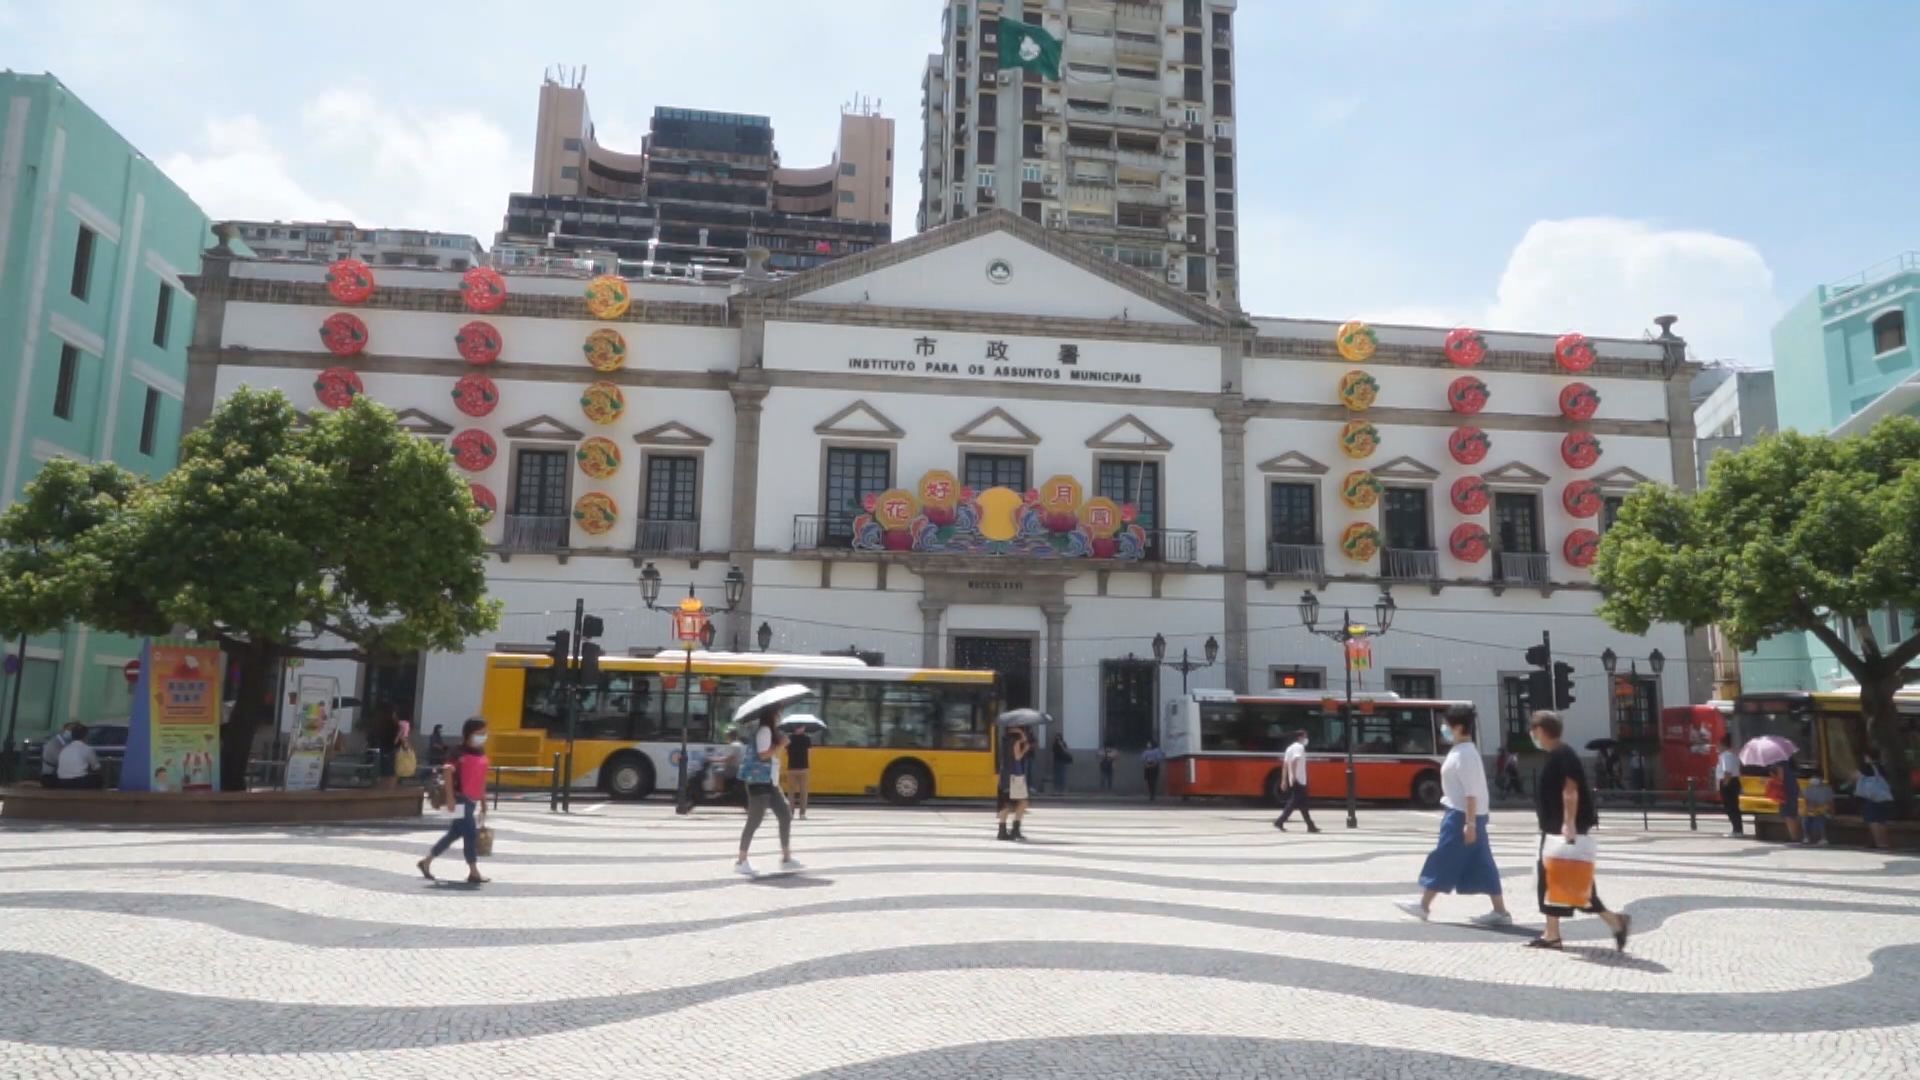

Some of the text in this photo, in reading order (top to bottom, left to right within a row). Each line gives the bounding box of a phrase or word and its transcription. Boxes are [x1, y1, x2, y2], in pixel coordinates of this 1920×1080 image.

[848, 358, 1142, 384] INSTITUTO PARA OS ASSUNTOS MUNICIPAIS
